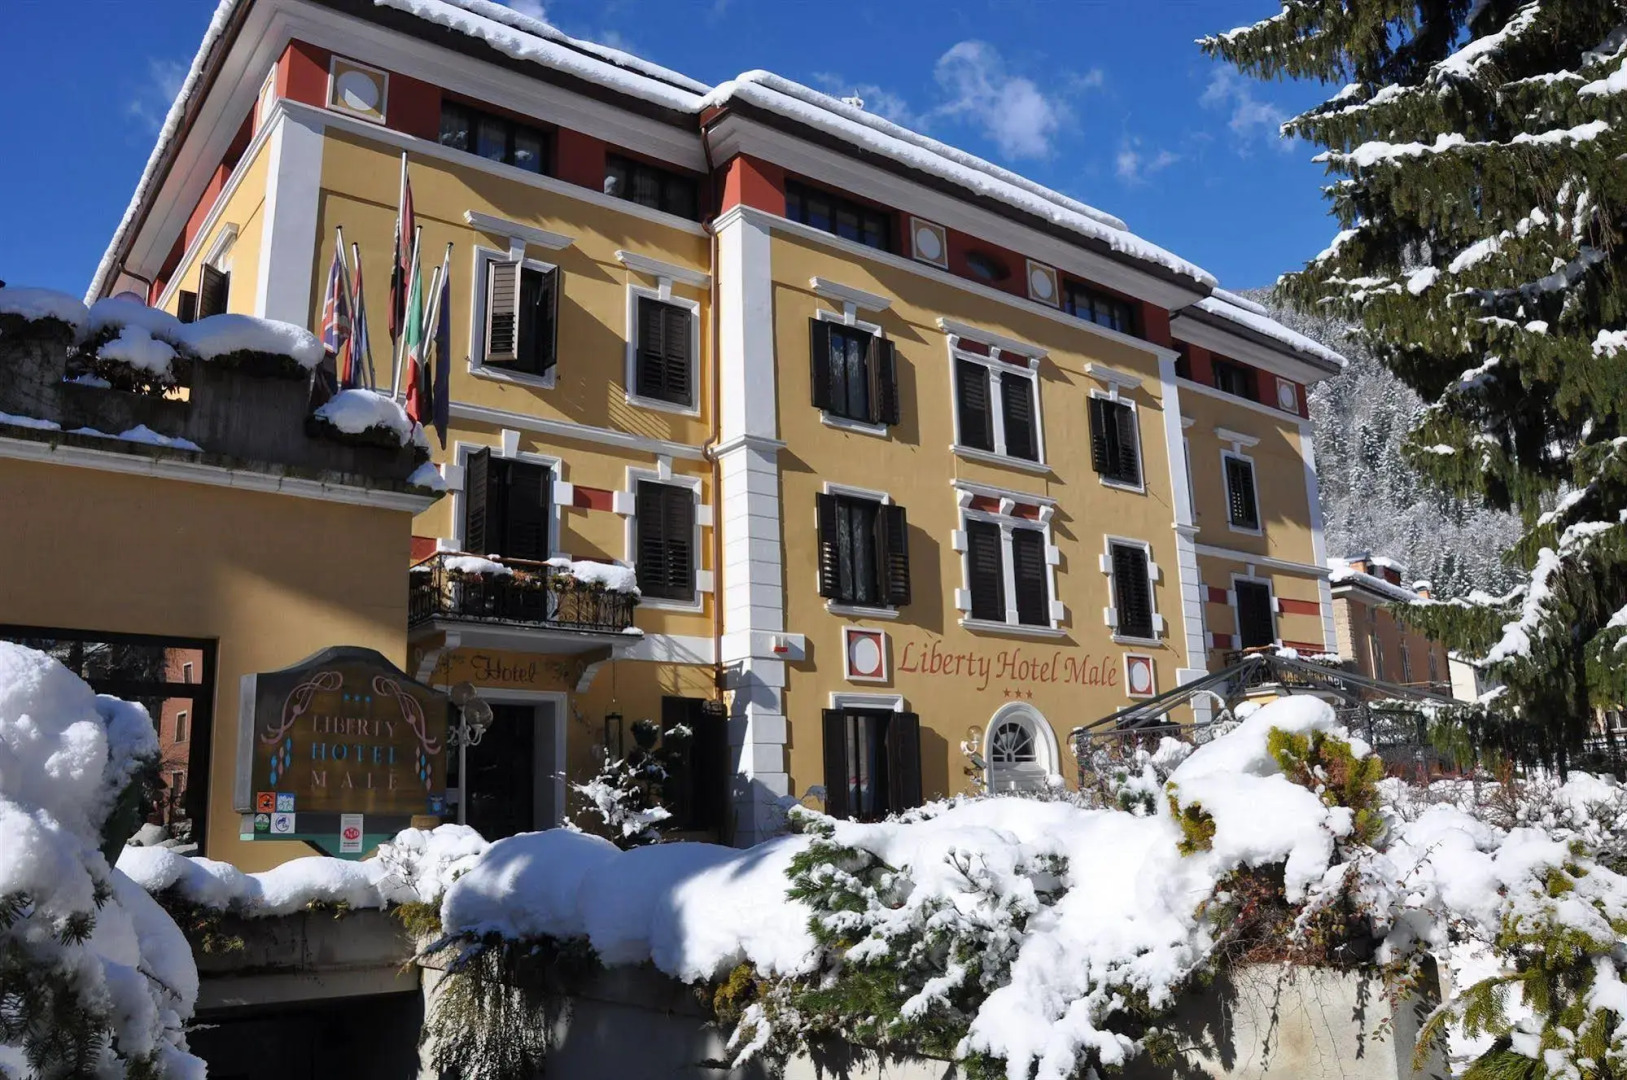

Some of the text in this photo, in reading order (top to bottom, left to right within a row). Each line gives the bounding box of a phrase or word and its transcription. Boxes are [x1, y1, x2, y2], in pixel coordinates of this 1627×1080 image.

[470, 654, 537, 683] Hotel
[897, 639, 1118, 691] Liberty Hotel Malé
[312, 714, 398, 738] LIBERTY
[311, 741, 398, 766] HOTEL
